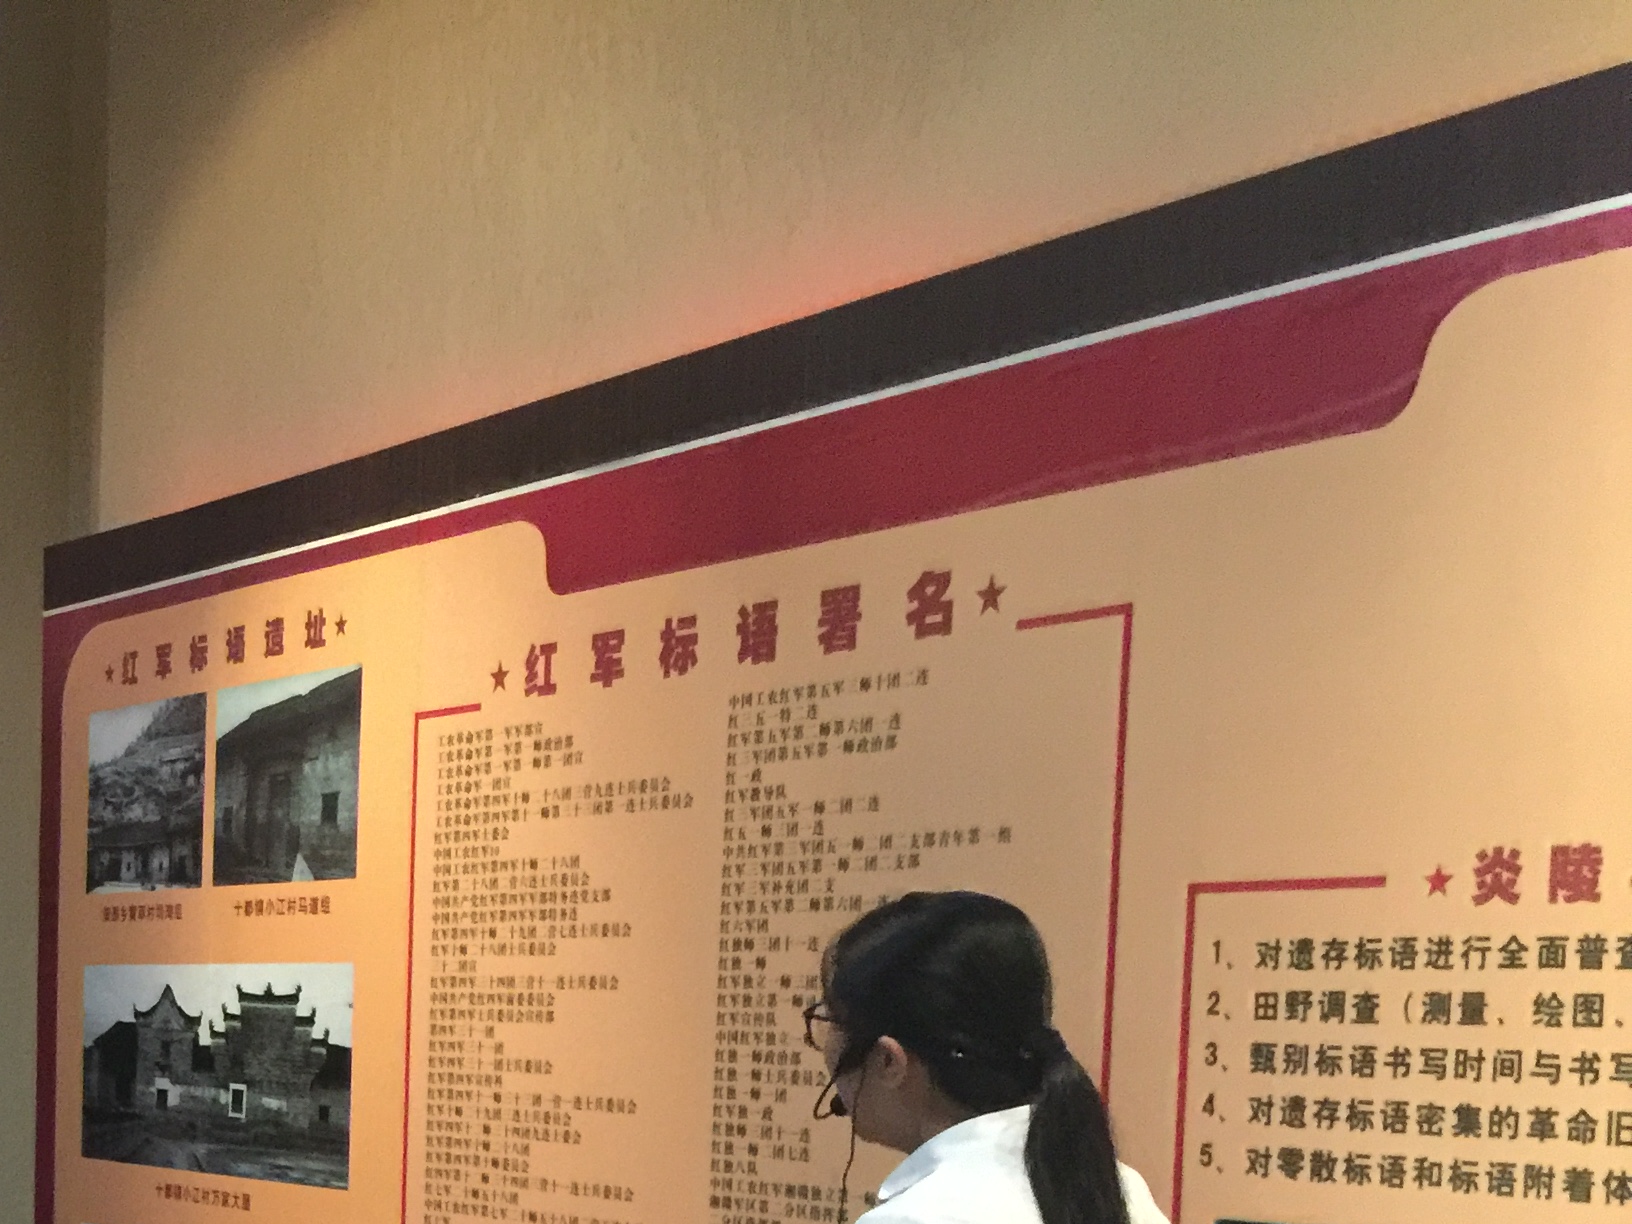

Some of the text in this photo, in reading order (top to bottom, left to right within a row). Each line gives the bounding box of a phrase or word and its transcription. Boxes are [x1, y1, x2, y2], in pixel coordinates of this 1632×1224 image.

[122, 607, 327, 686] 红军标语遗址
[524, 569, 955, 698] 红军标语署名
[1471, 842, 1603, 906] 炎陵
